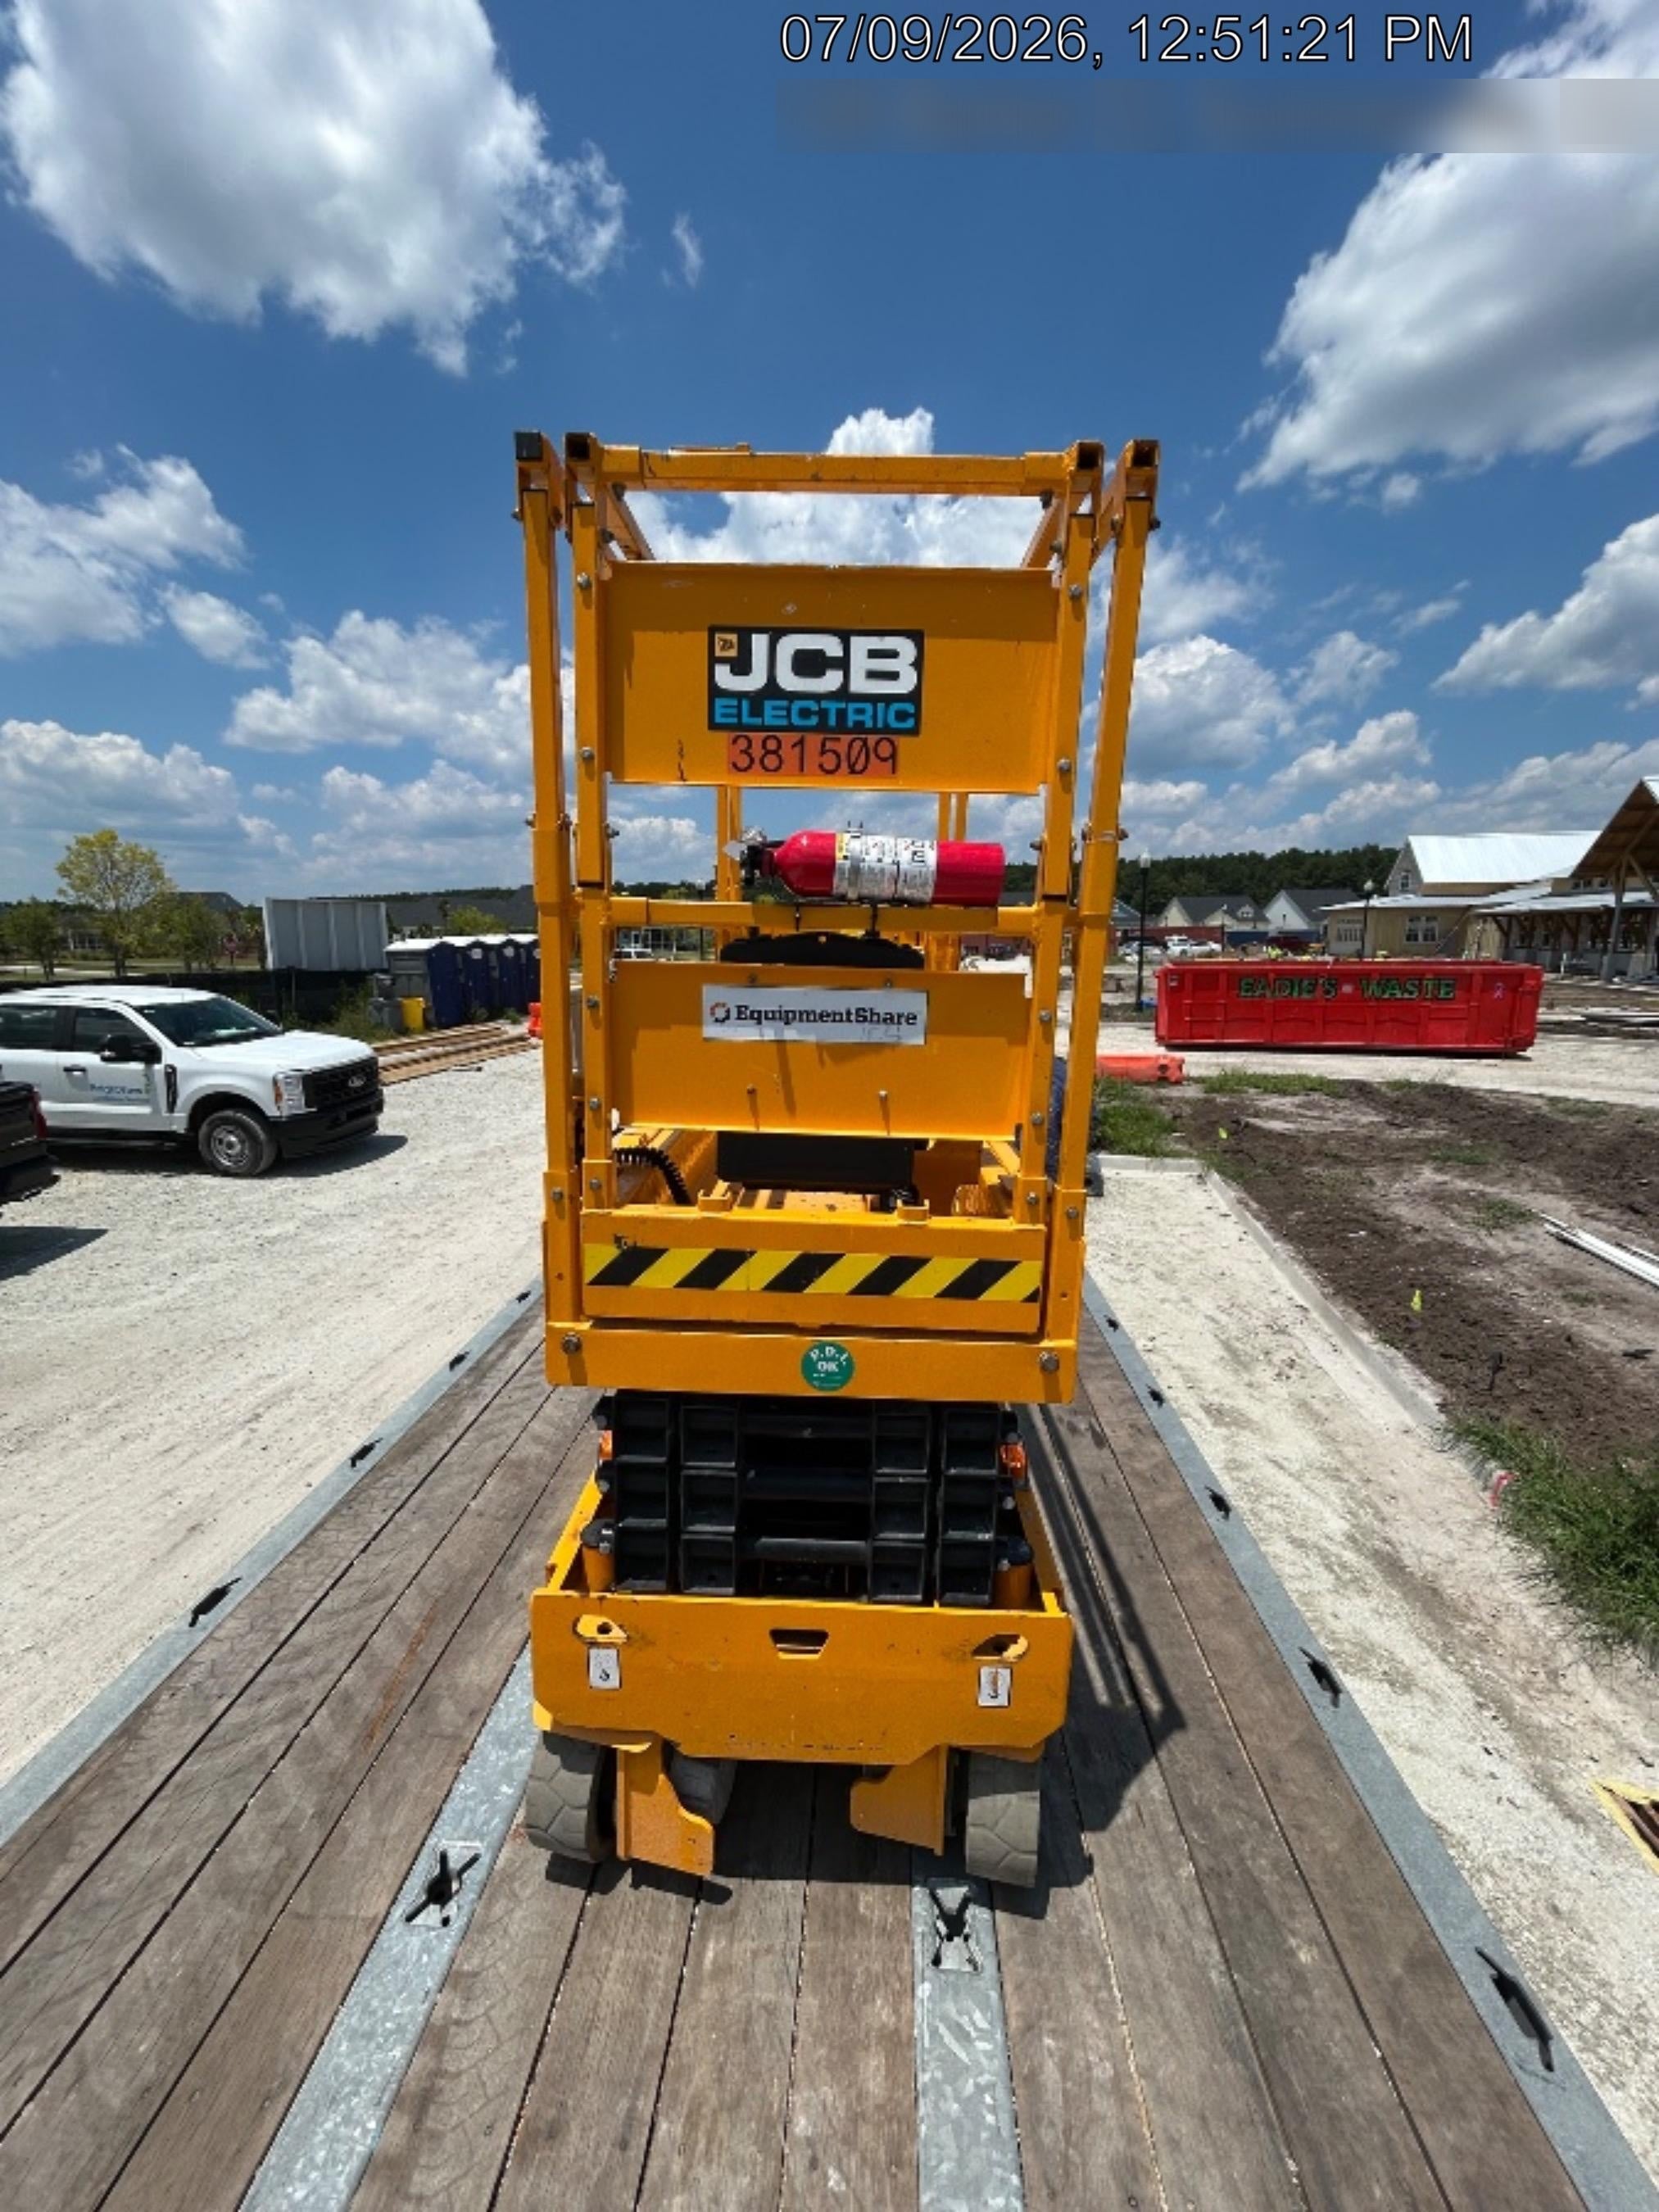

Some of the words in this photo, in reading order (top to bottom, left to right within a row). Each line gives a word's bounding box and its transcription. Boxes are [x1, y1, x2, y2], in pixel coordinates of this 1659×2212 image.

[714, 632, 918, 695] JCB
[714, 697, 915, 729] ELECTRIC
[731, 734, 898, 775] 381509
[1239, 977, 1337, 999] EADIE'S
[1360, 977, 1457, 1000] WASTE
[734, 1004, 918, 1025] EquipmentShare
[818, 1361, 839, 1372] OK
